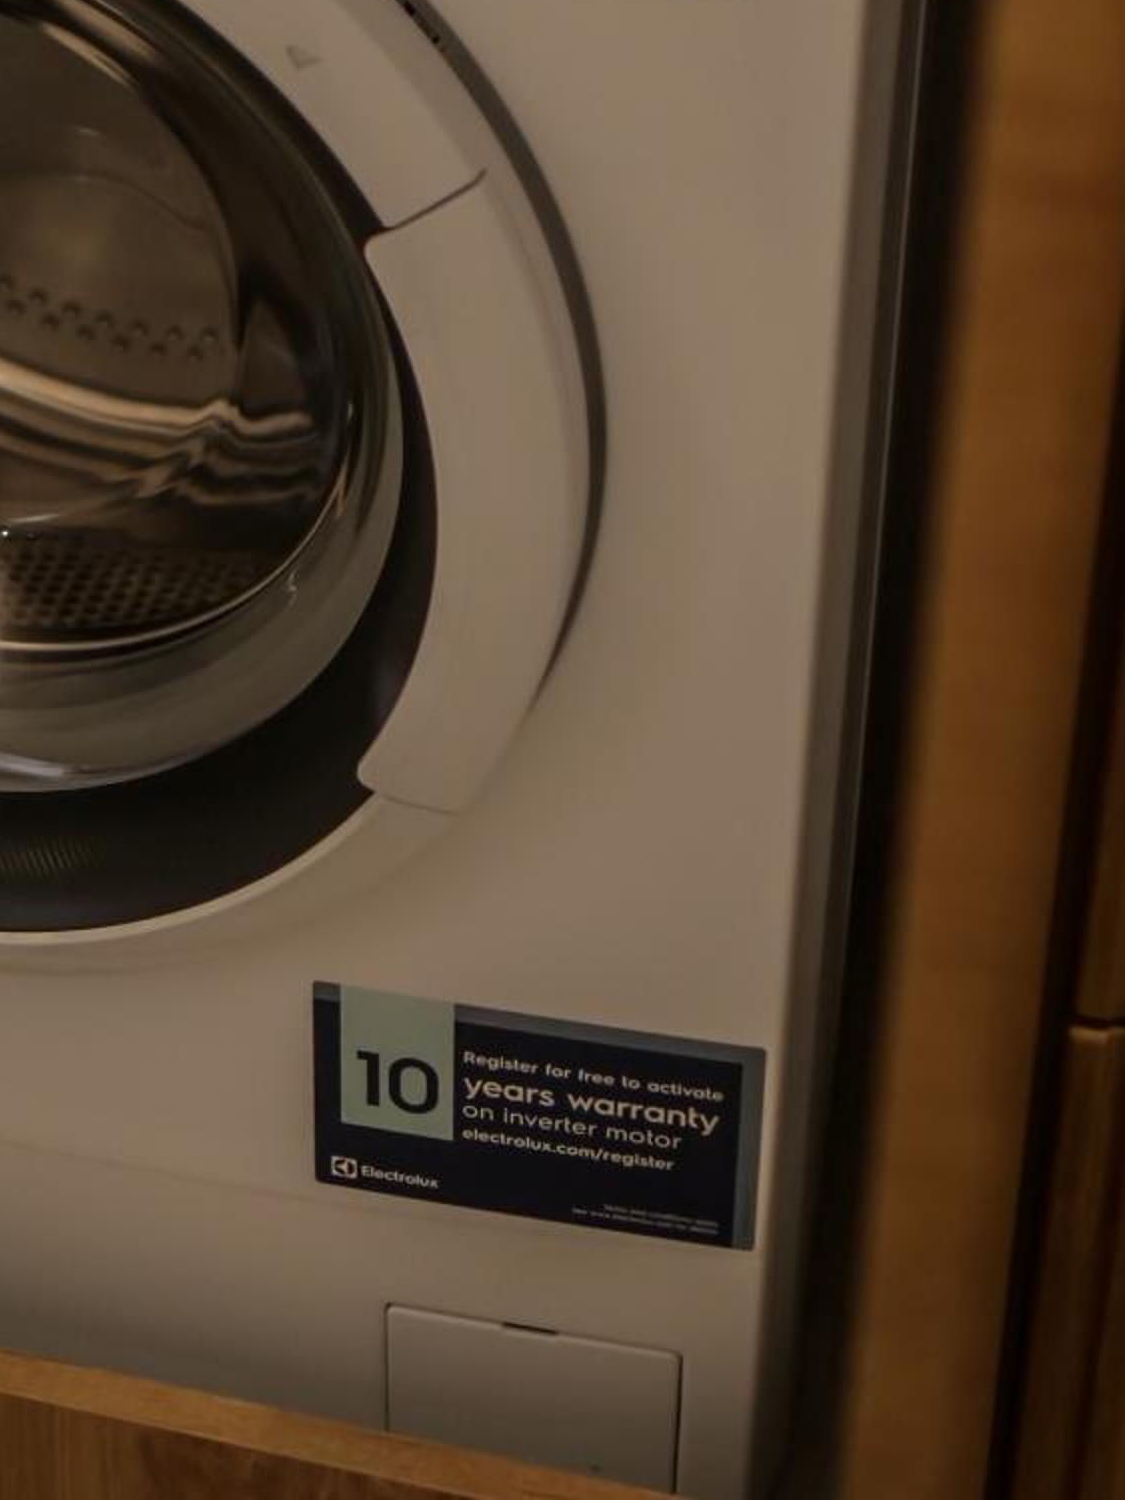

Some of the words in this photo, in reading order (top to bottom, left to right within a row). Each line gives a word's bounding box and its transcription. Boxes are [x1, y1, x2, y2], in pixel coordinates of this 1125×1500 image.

[356, 1050, 440, 1116] 10
[462, 1050, 539, 1077] Register
[545, 1061, 572, 1080] for
[578, 1067, 615, 1087] free
[622, 1074, 641, 1091] to
[647, 1078, 724, 1102] activate
[462, 1103, 494, 1121] on
[503, 1106, 597, 1137] inverter
[606, 1124, 682, 1150] motor
[463, 1076, 556, 1109] years
[567, 1091, 720, 1137] warranty
[462, 1126, 675, 1171] electrolux.com/register
[361, 1164, 440, 1190] Electrolux
